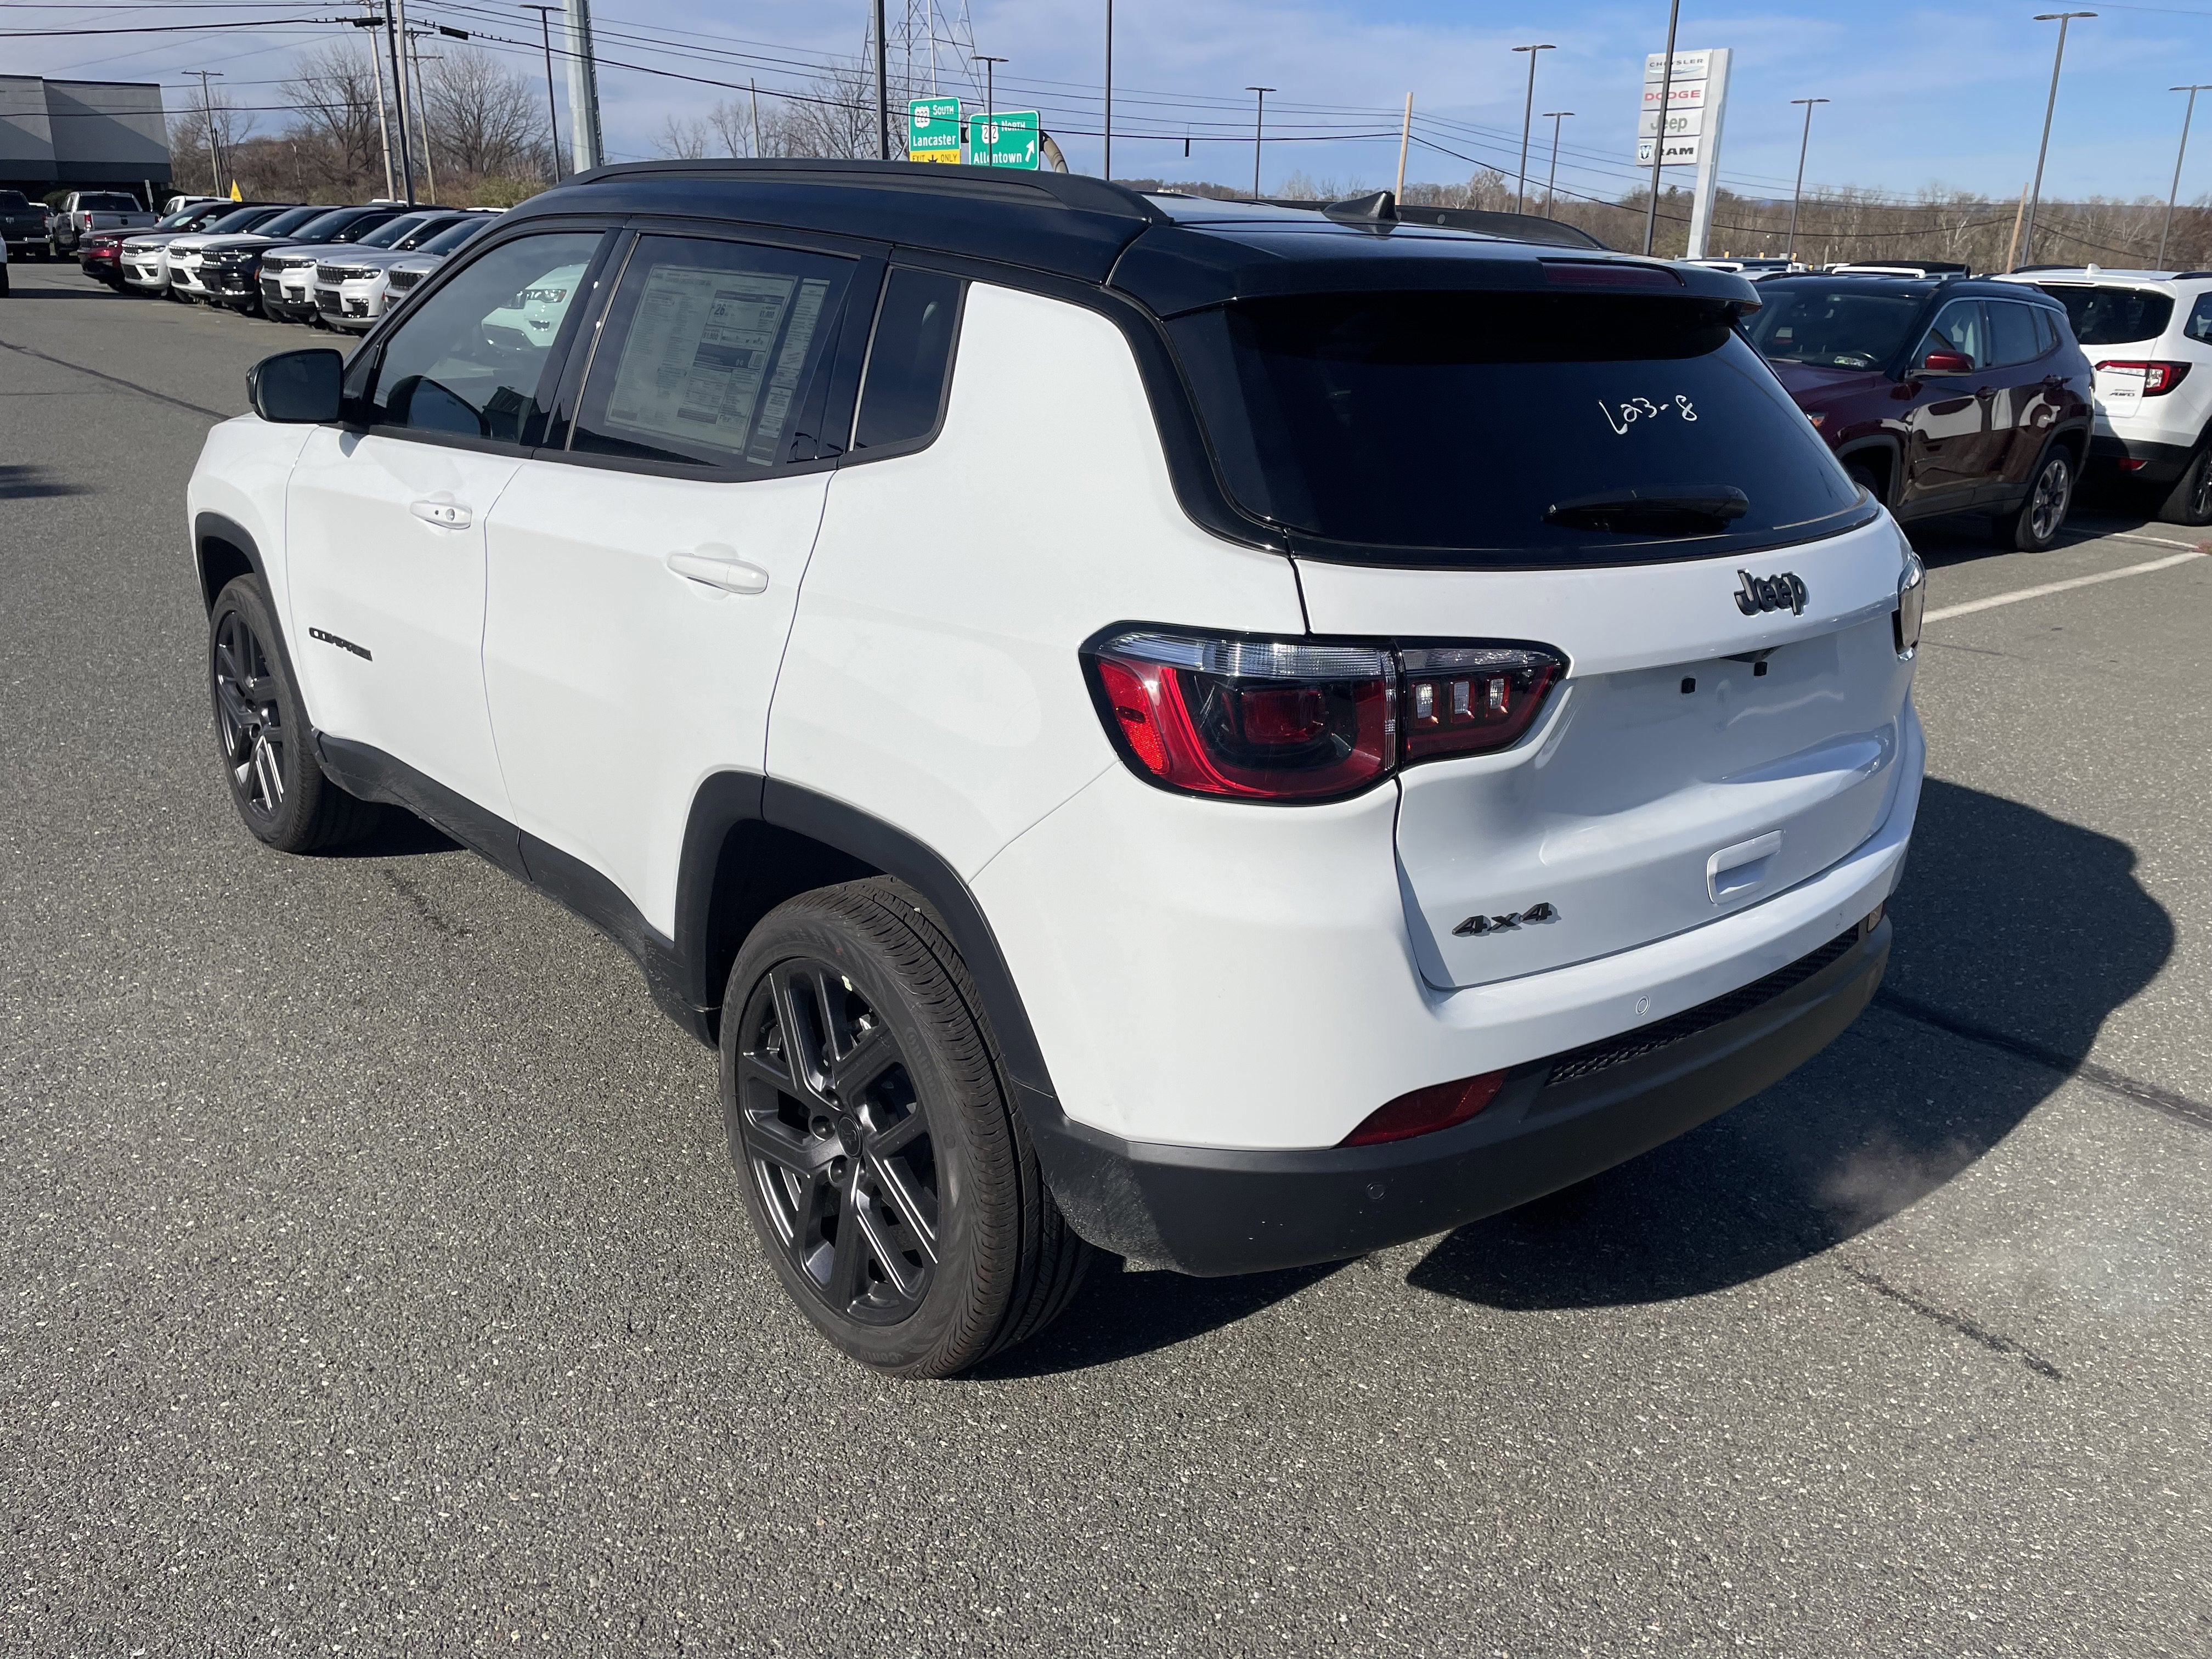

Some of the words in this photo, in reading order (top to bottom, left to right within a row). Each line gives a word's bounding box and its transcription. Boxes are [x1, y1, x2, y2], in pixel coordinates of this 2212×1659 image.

[1650, 59, 1703, 67] CHSLER
[917, 111, 928, 123] 222
[933, 104, 954, 115] SOUTH
[984, 127, 997, 139] 22
[1001, 120, 1026, 132] NORTH
[913, 134, 956, 146] Lancaster
[940, 154, 957, 162] ONLY
[1734, 568, 1807, 617] Jeep
